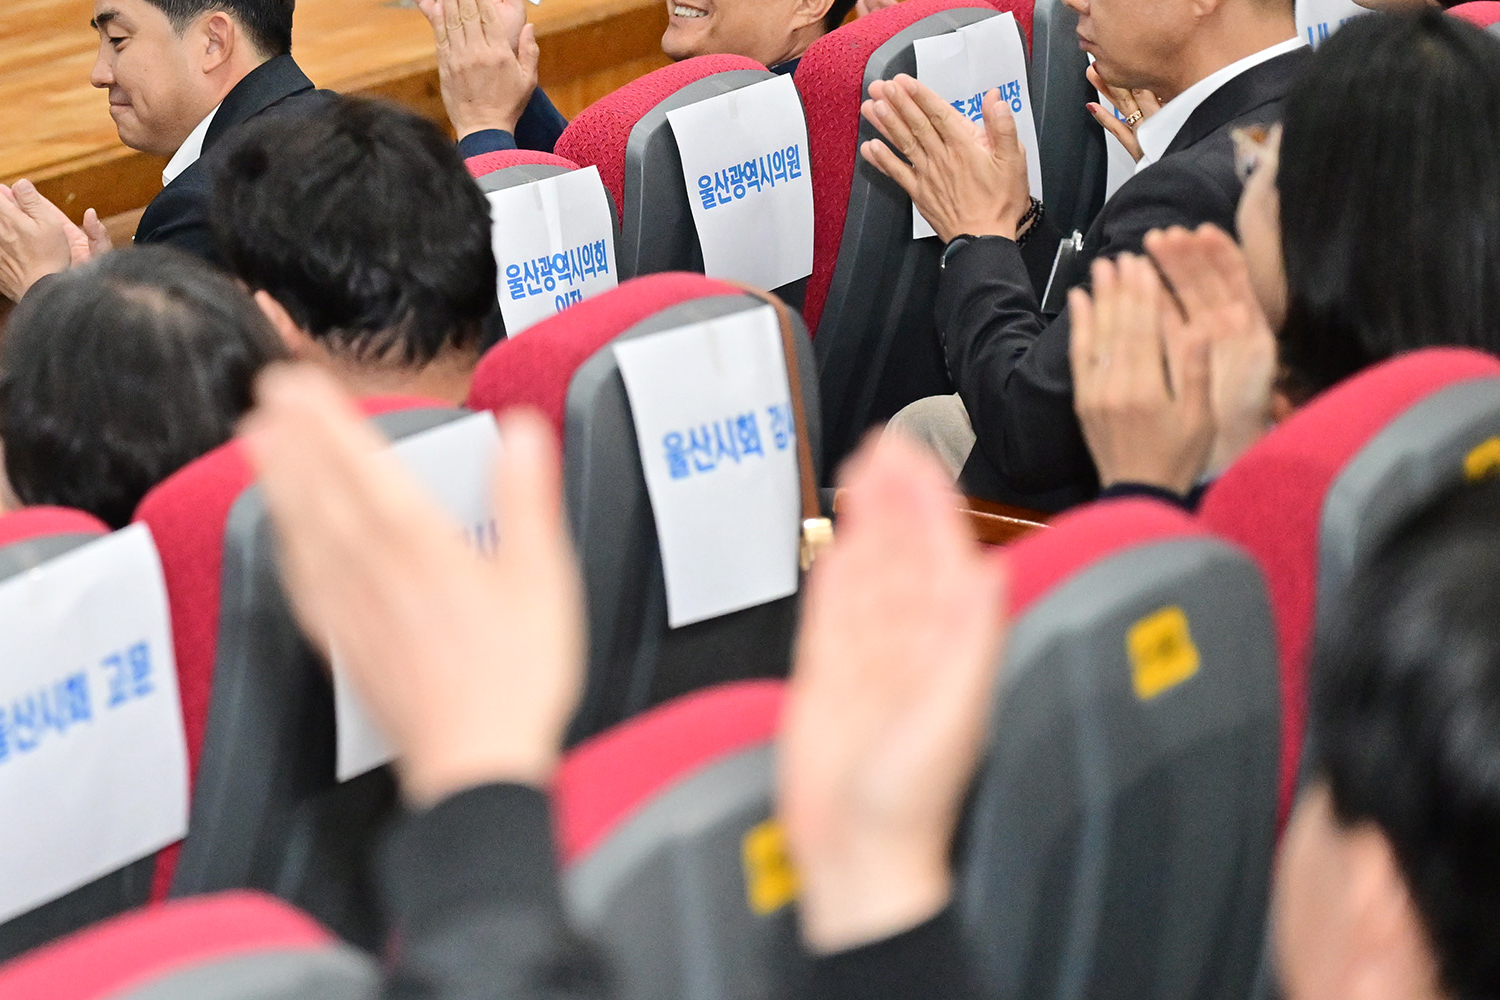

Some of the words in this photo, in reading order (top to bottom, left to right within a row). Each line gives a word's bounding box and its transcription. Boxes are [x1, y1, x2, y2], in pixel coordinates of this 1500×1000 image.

[697, 143, 803, 211] 울산광역시의원
[505, 238, 610, 302] 울산광역시의회
[662, 411, 764, 481] 울산시회
